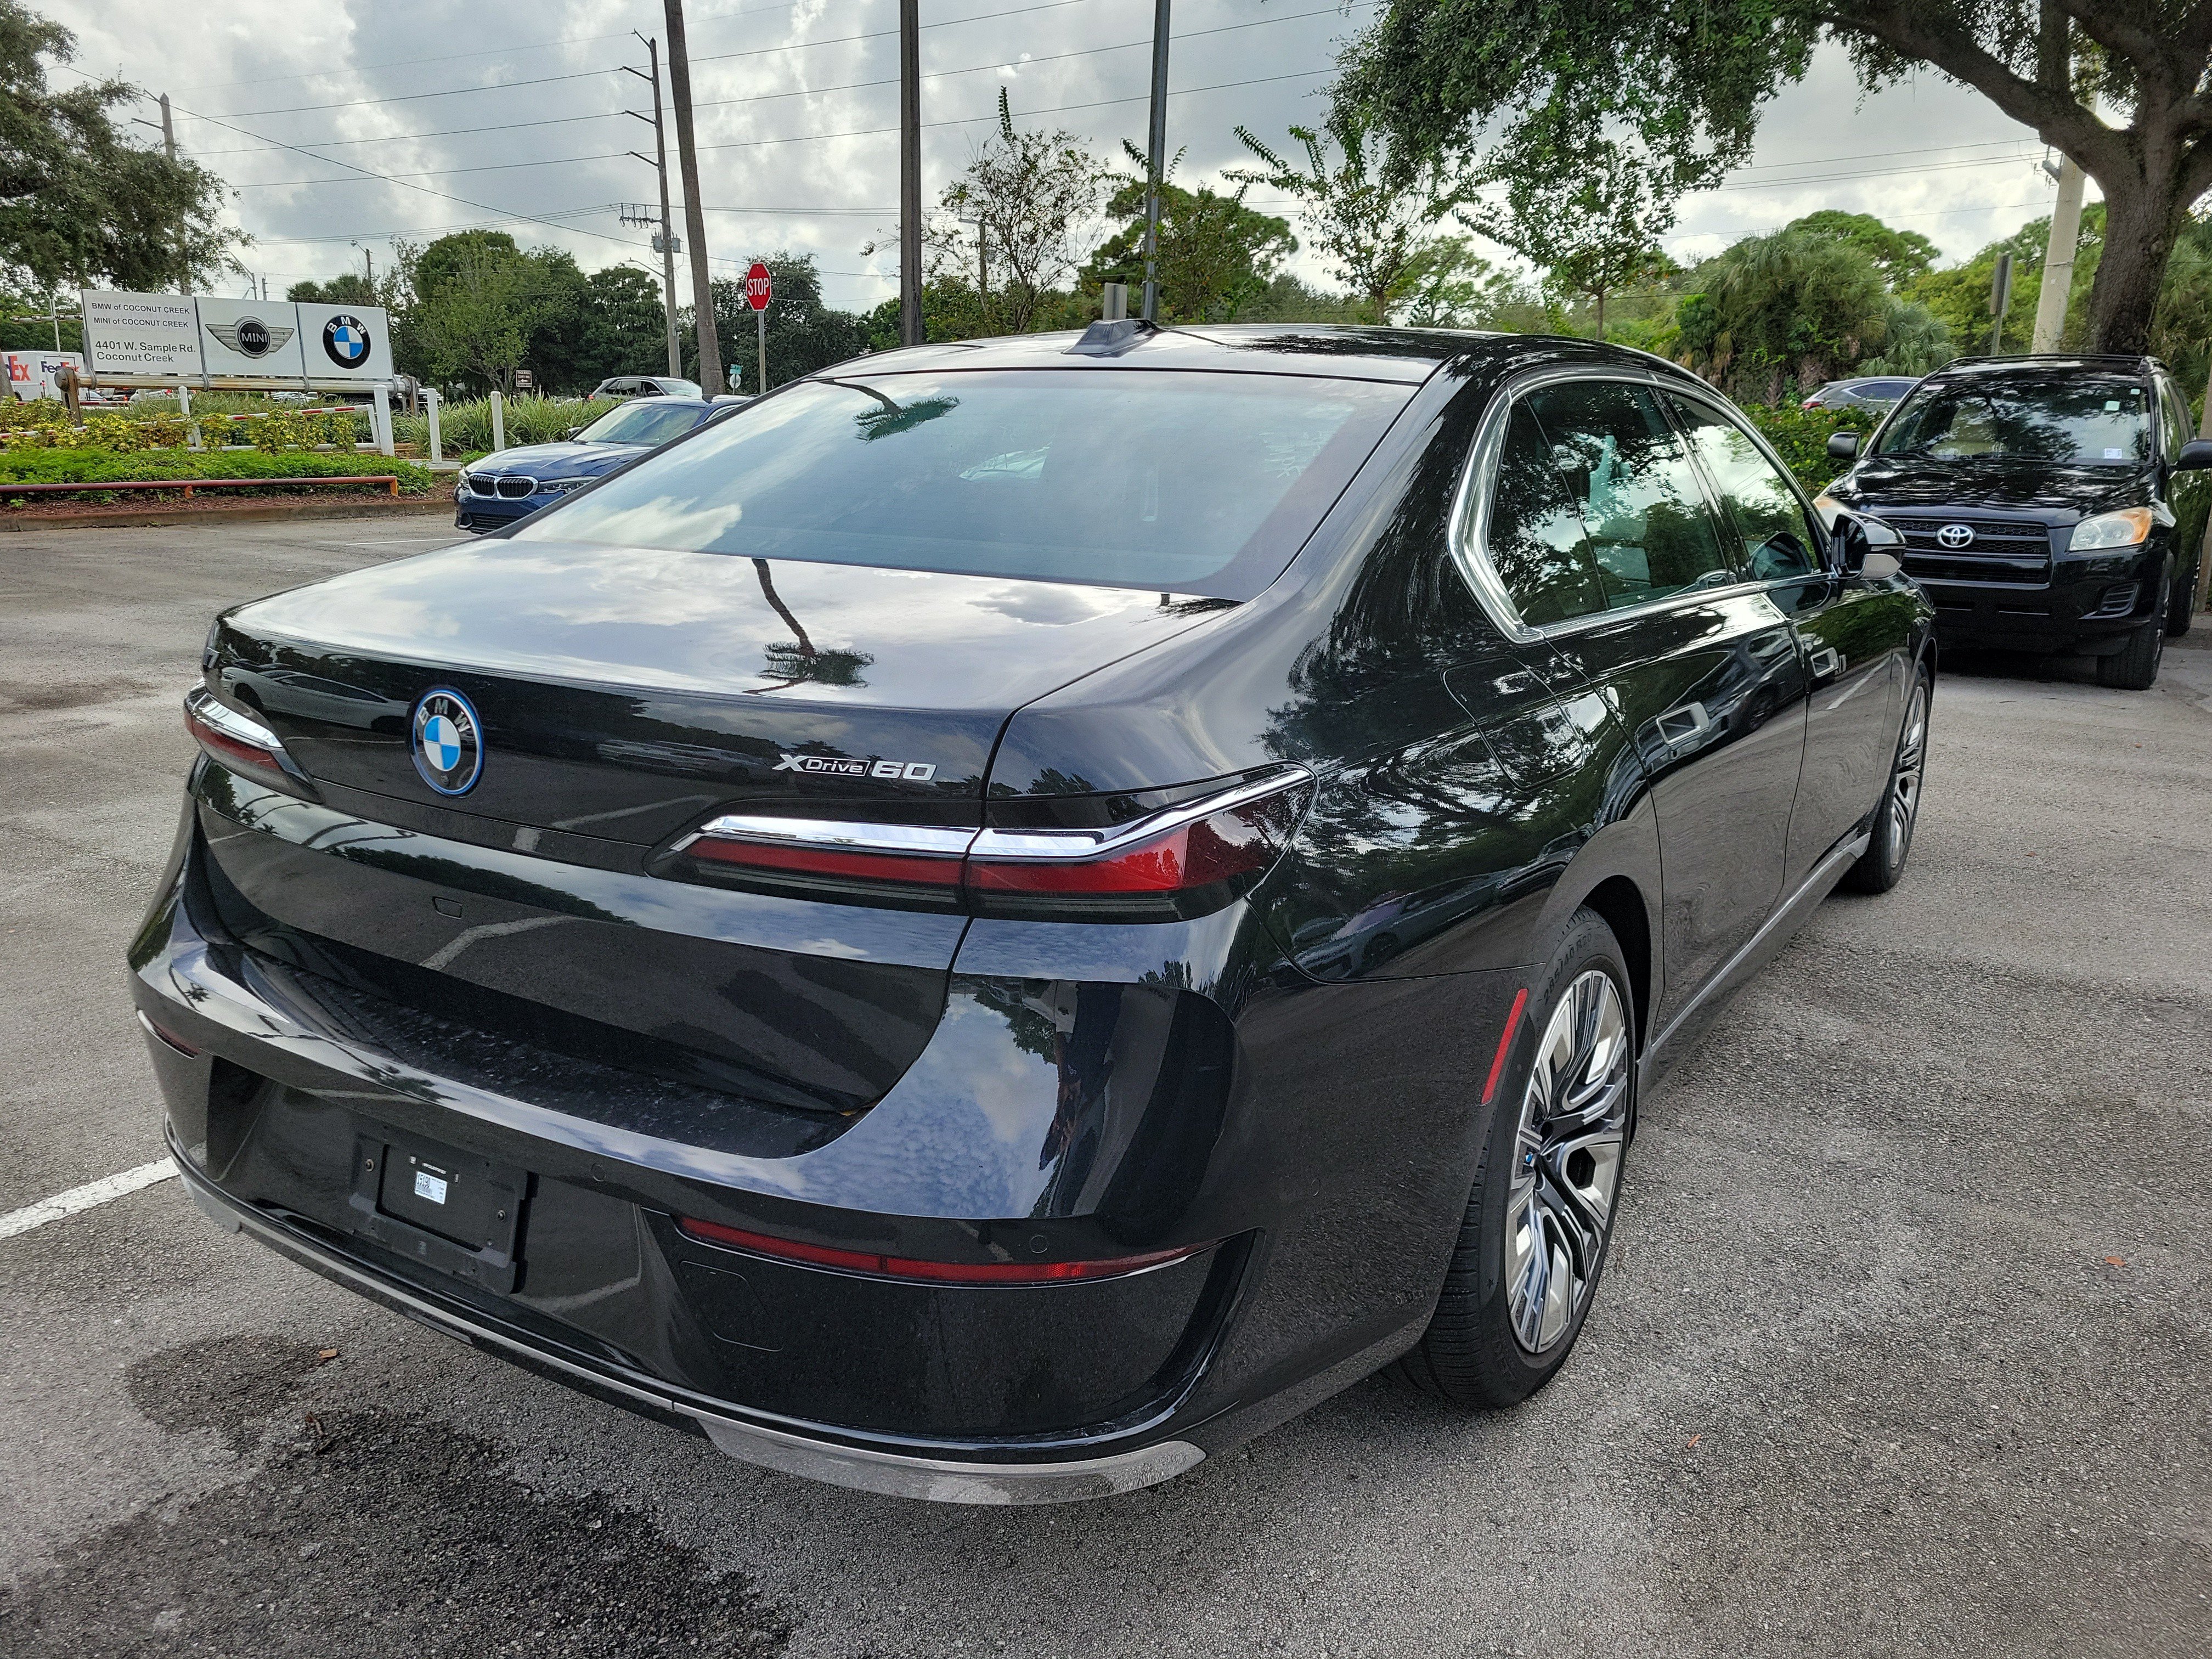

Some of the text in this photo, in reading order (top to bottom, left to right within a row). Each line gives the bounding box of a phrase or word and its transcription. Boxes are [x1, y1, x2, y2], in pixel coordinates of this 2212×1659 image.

[748, 278, 769, 296] STOP
[123, 304, 161, 313] COCONUT
[327, 317, 366, 335] BMW
[241, 332, 268, 343] MINI
[95, 341, 196, 354] 4401 W. Sample Rd.
[97, 352, 174, 362] Coconut Creek
[418, 698, 471, 732] BMW
[871, 760, 937, 781] 60
